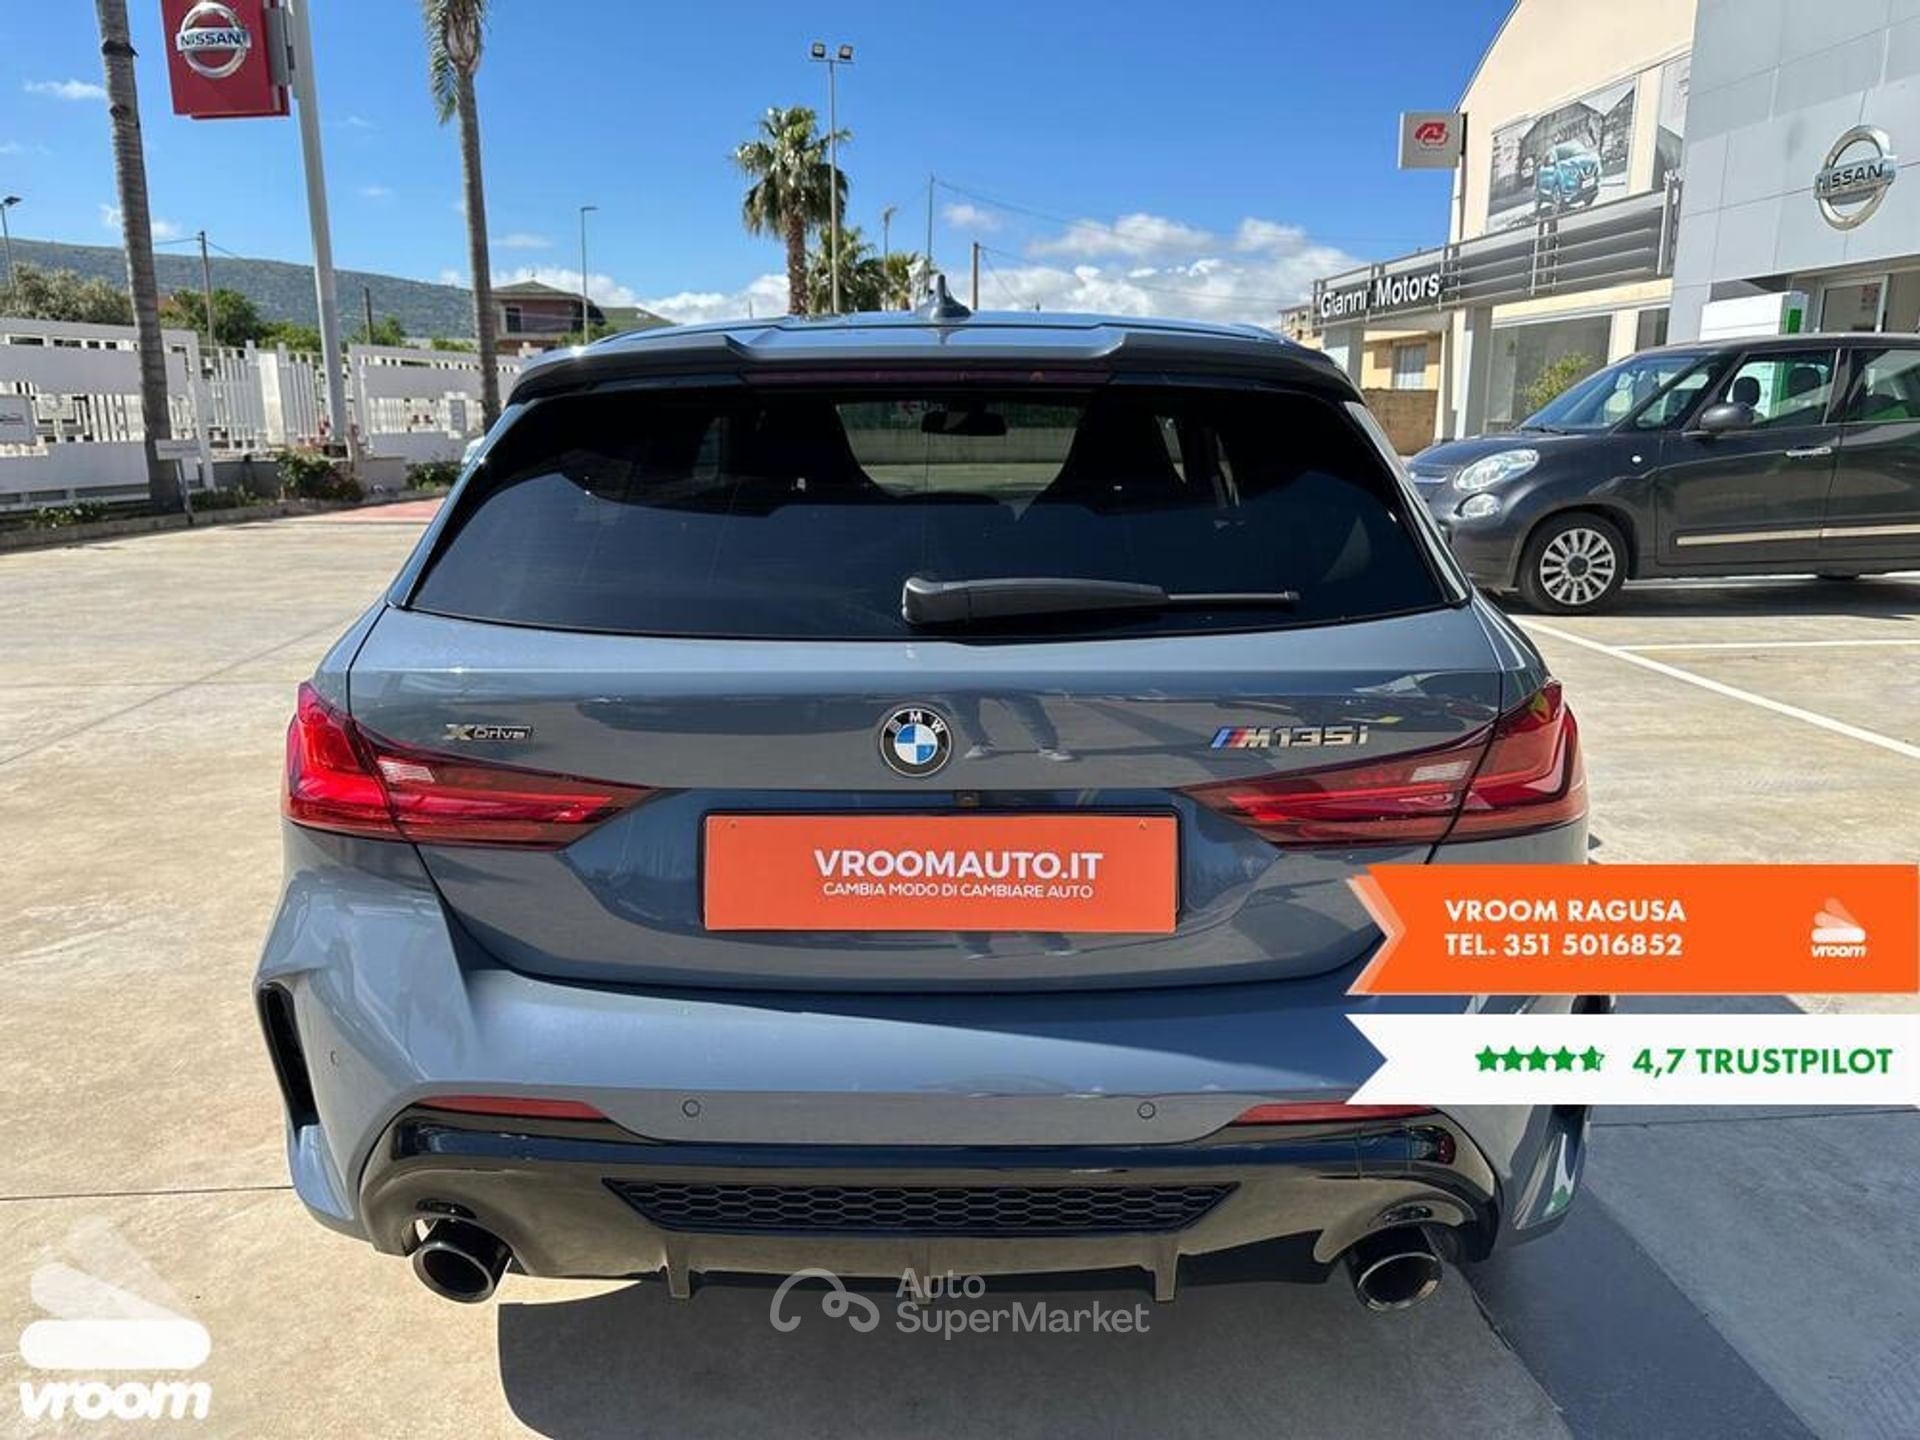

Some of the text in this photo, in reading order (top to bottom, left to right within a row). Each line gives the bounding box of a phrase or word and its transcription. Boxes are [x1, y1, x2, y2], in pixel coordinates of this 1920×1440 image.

[180, 30, 241, 47] NISSAN
[1818, 163, 1884, 190] NISSAN
[1321, 274, 1440, 318] Gianni Motors
[887, 711, 945, 734] BMW
[814, 850, 1103, 879] VROOMAUTO.IT
[823, 882, 1093, 898] CAMBIA MODO DI CAMBIARE AUTO
